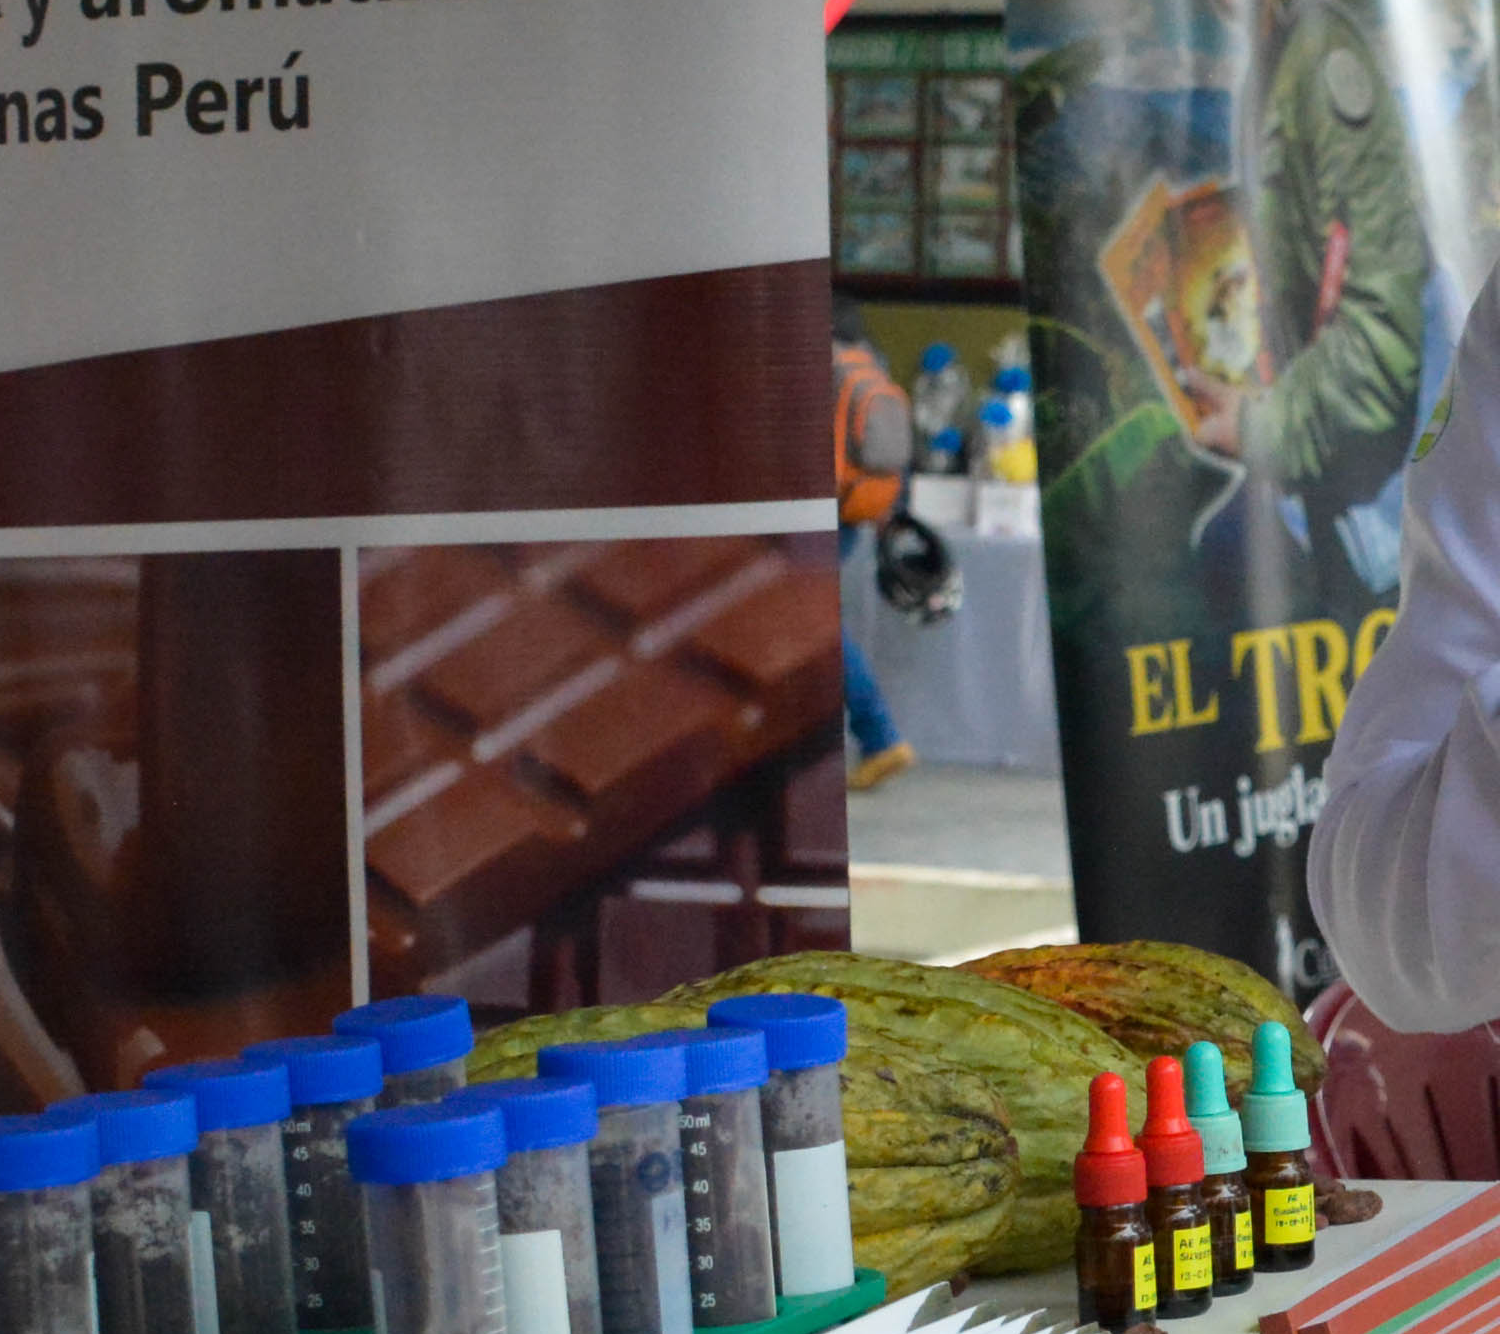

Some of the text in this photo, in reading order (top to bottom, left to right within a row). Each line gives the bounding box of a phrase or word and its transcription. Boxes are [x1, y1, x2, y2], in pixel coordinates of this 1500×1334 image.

[133, 51, 312, 138] Perú
[1125, 637, 1220, 739] EL
[1161, 785, 1230, 854] Un
[291, 1146, 310, 1162] 45
[690, 1141, 708, 1156] 45
[296, 1182, 313, 1197] 40
[693, 1179, 710, 1195] 40
[299, 1219, 316, 1235] 35
[695, 1217, 713, 1233] 35
[303, 1256, 320, 1271] 30
[697, 1254, 715, 1271] 30
[307, 1293, 324, 1308] 25
[699, 1292, 717, 1308] 25
